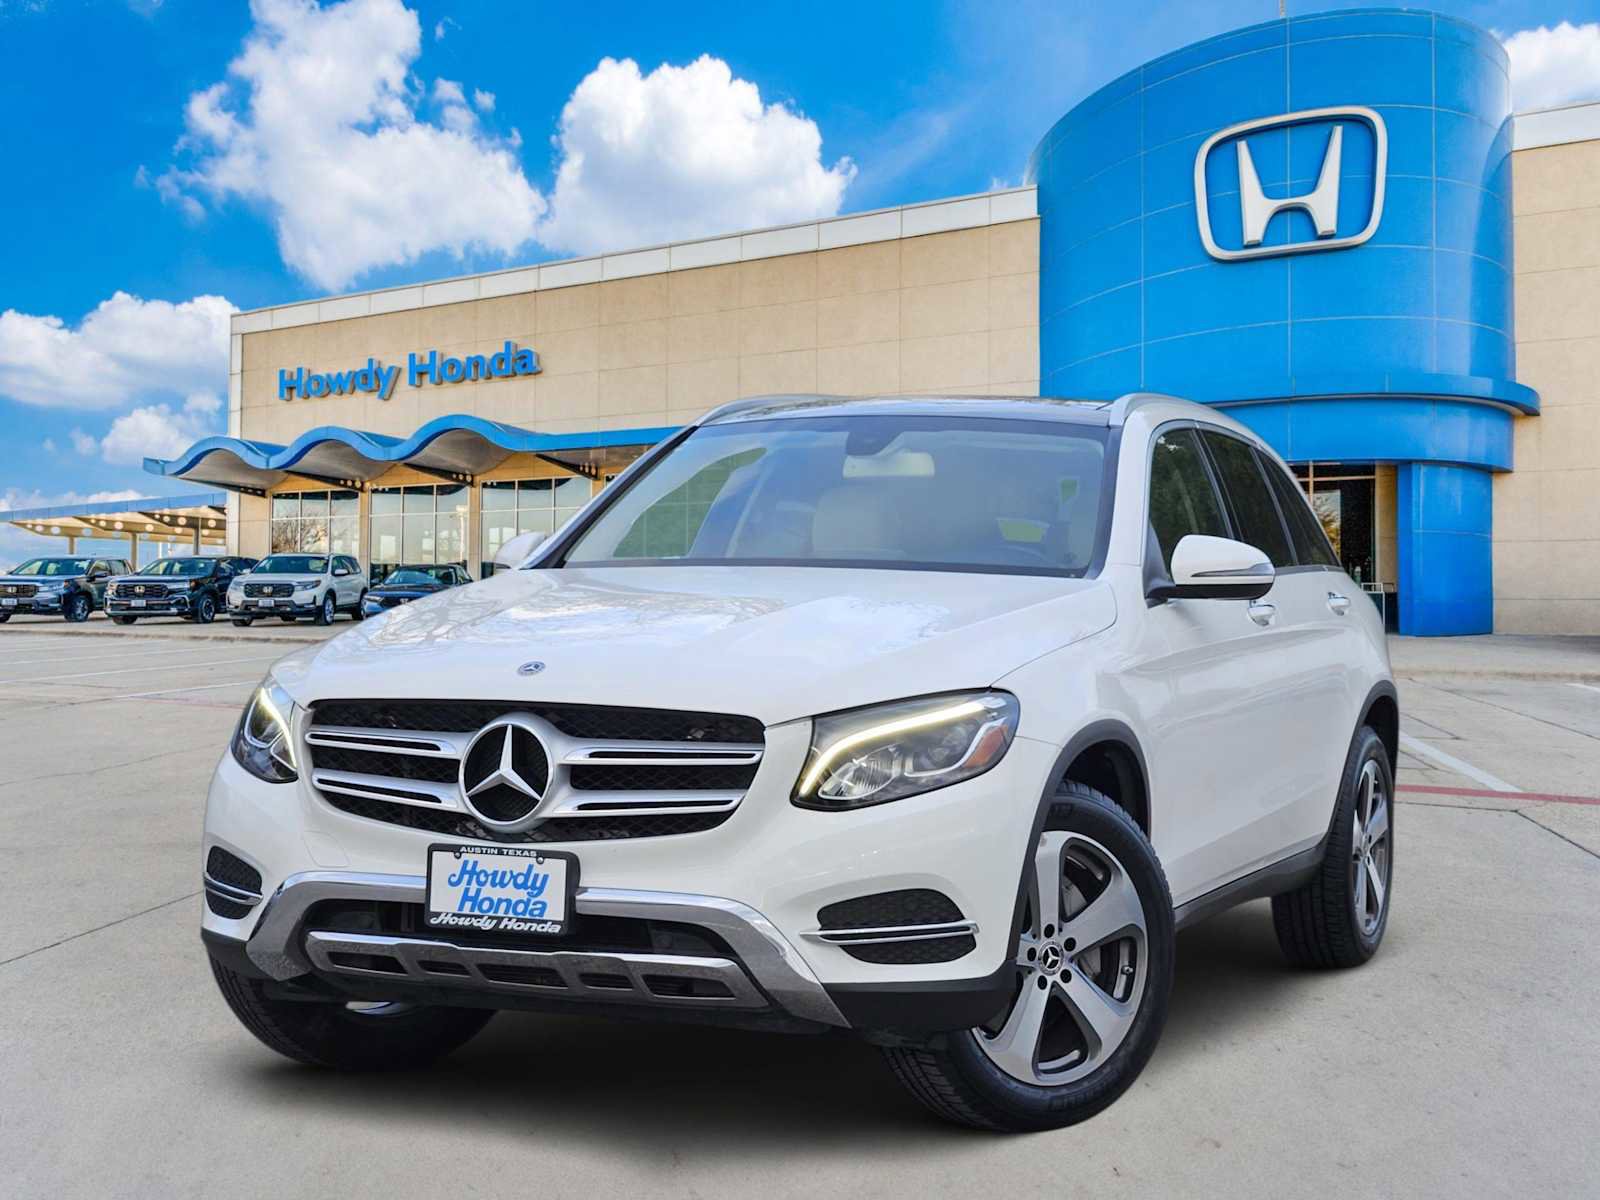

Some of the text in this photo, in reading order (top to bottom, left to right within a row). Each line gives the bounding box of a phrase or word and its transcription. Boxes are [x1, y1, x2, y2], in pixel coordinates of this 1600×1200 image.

[278, 340, 542, 401] Howdy Honda
[460, 846, 537, 857] AUSTIN TEXAS
[448, 859, 549, 898] Howdy
[457, 887, 548, 918] Honda
[430, 912, 561, 934] Howdy Honda
